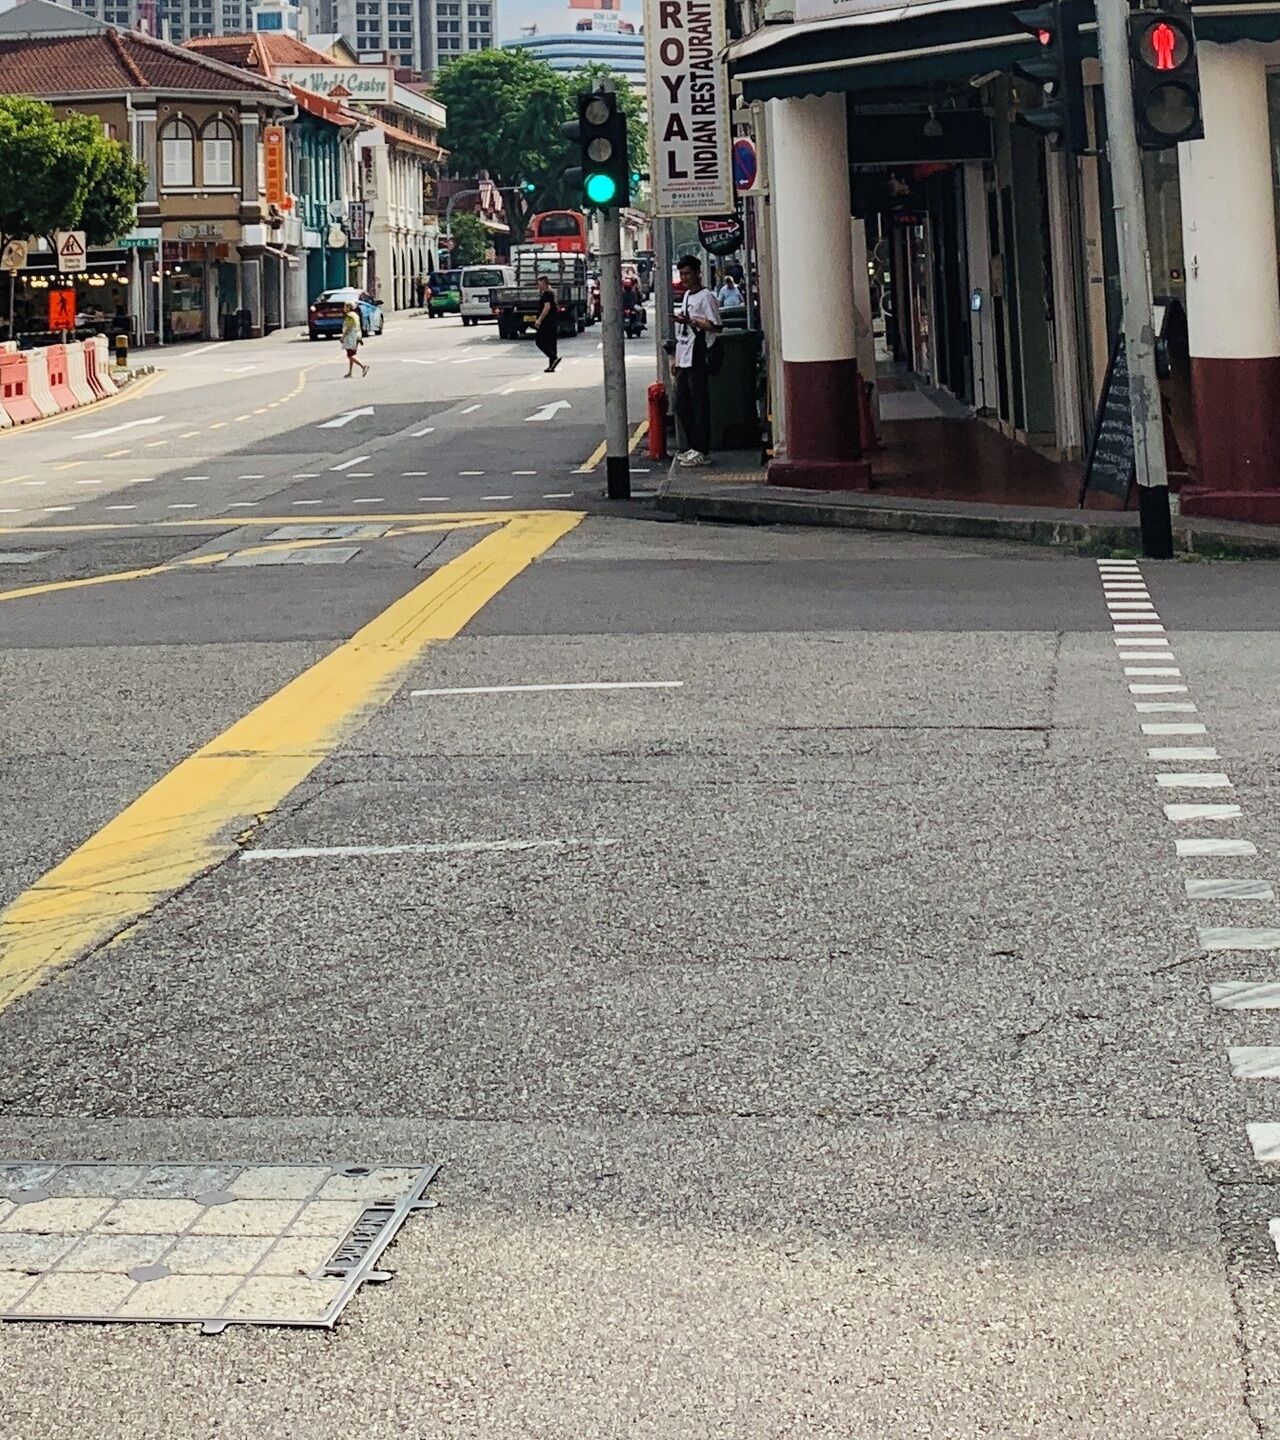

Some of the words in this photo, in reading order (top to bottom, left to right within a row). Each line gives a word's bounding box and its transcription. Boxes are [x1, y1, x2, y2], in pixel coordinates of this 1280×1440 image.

[347, 72, 386, 92] Centre
[659, 0, 689, 179] ROYAL
[687, 0, 716, 116] RESTAURANT
[692, 120, 719, 180] INDIAN
